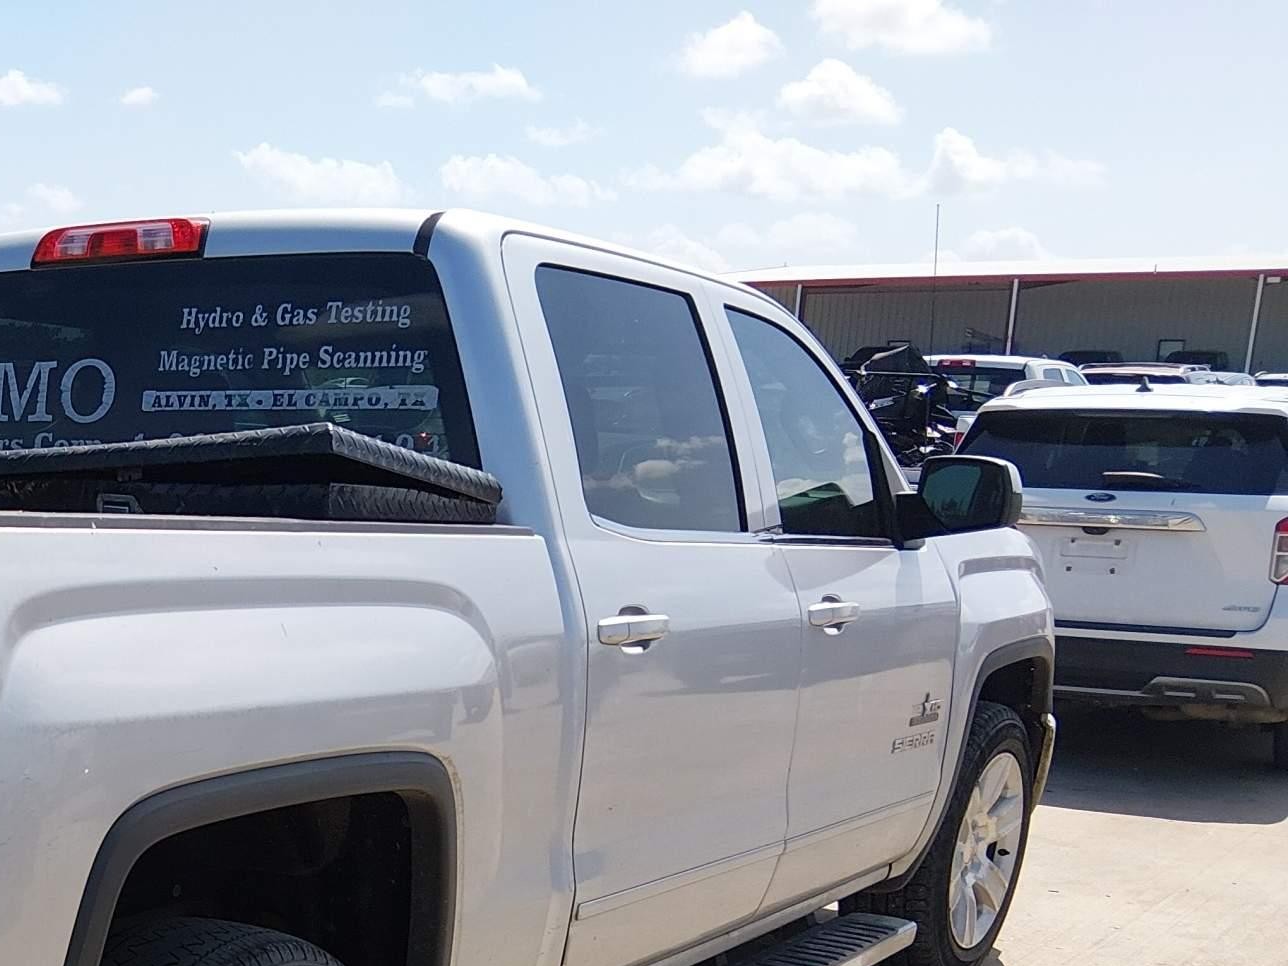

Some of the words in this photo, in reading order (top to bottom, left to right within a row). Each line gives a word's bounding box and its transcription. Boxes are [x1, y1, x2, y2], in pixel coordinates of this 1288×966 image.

[180, 307, 244, 334] Hydro
[251, 305, 268, 327] &
[276, 303, 318, 326] Gas
[326, 300, 411, 327] Testing
[158, 347, 254, 377] Magnetic
[261, 347, 310, 375] Pipe
[317, 344, 428, 373] Scanning
[151, 394, 217, 409] ALVIN,
[224, 394, 249, 408] TX
[271, 393, 297, 407] EL
